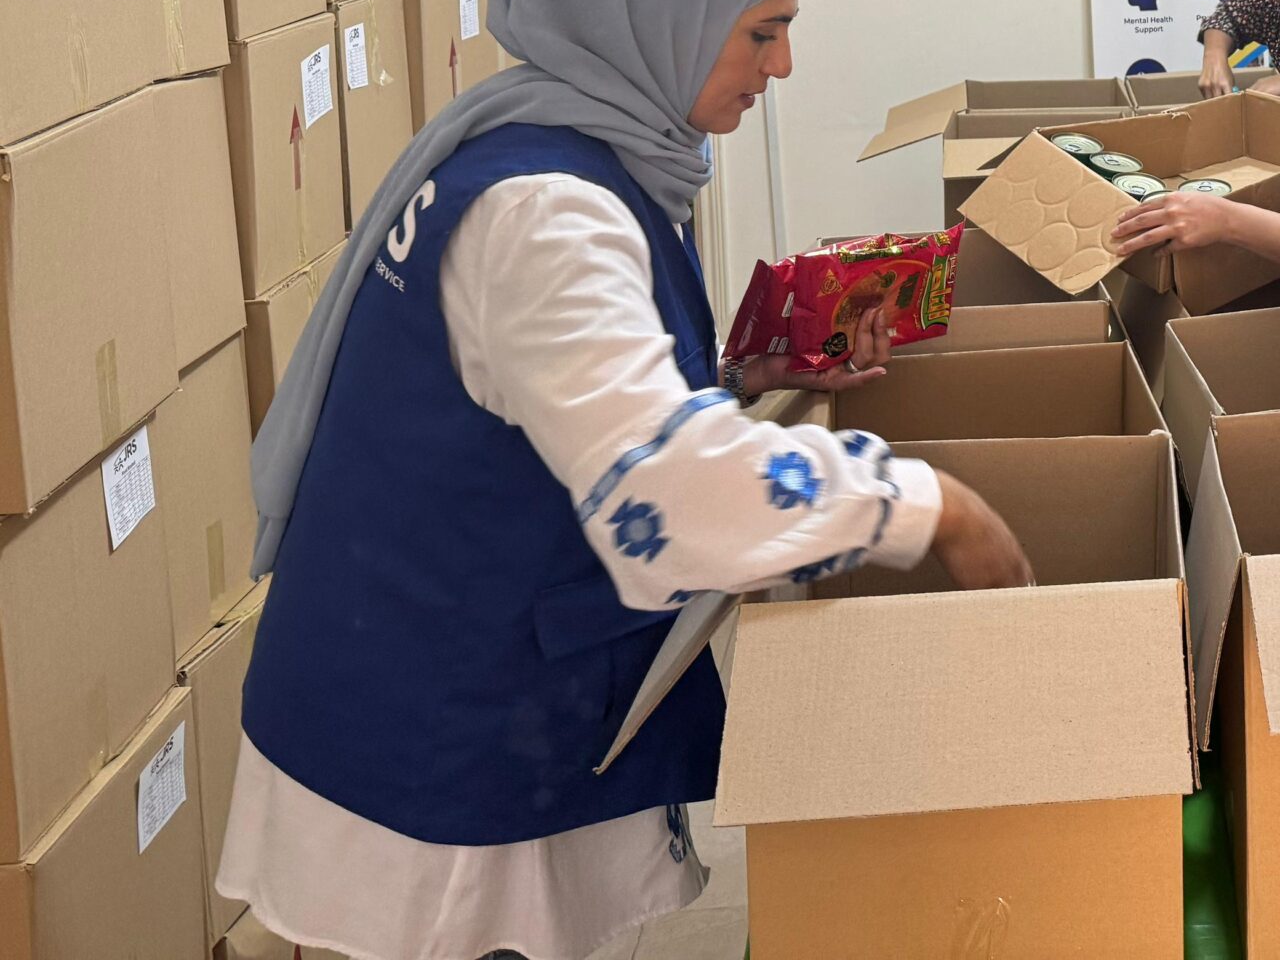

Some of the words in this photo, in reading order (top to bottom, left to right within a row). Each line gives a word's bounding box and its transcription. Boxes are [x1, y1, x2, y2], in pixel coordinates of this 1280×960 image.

[1124, 17, 1149, 25] Mental
[1150, 16, 1173, 24] Health
[375, 257, 405, 292] ERVICE
[123, 438, 137, 461] JRS
